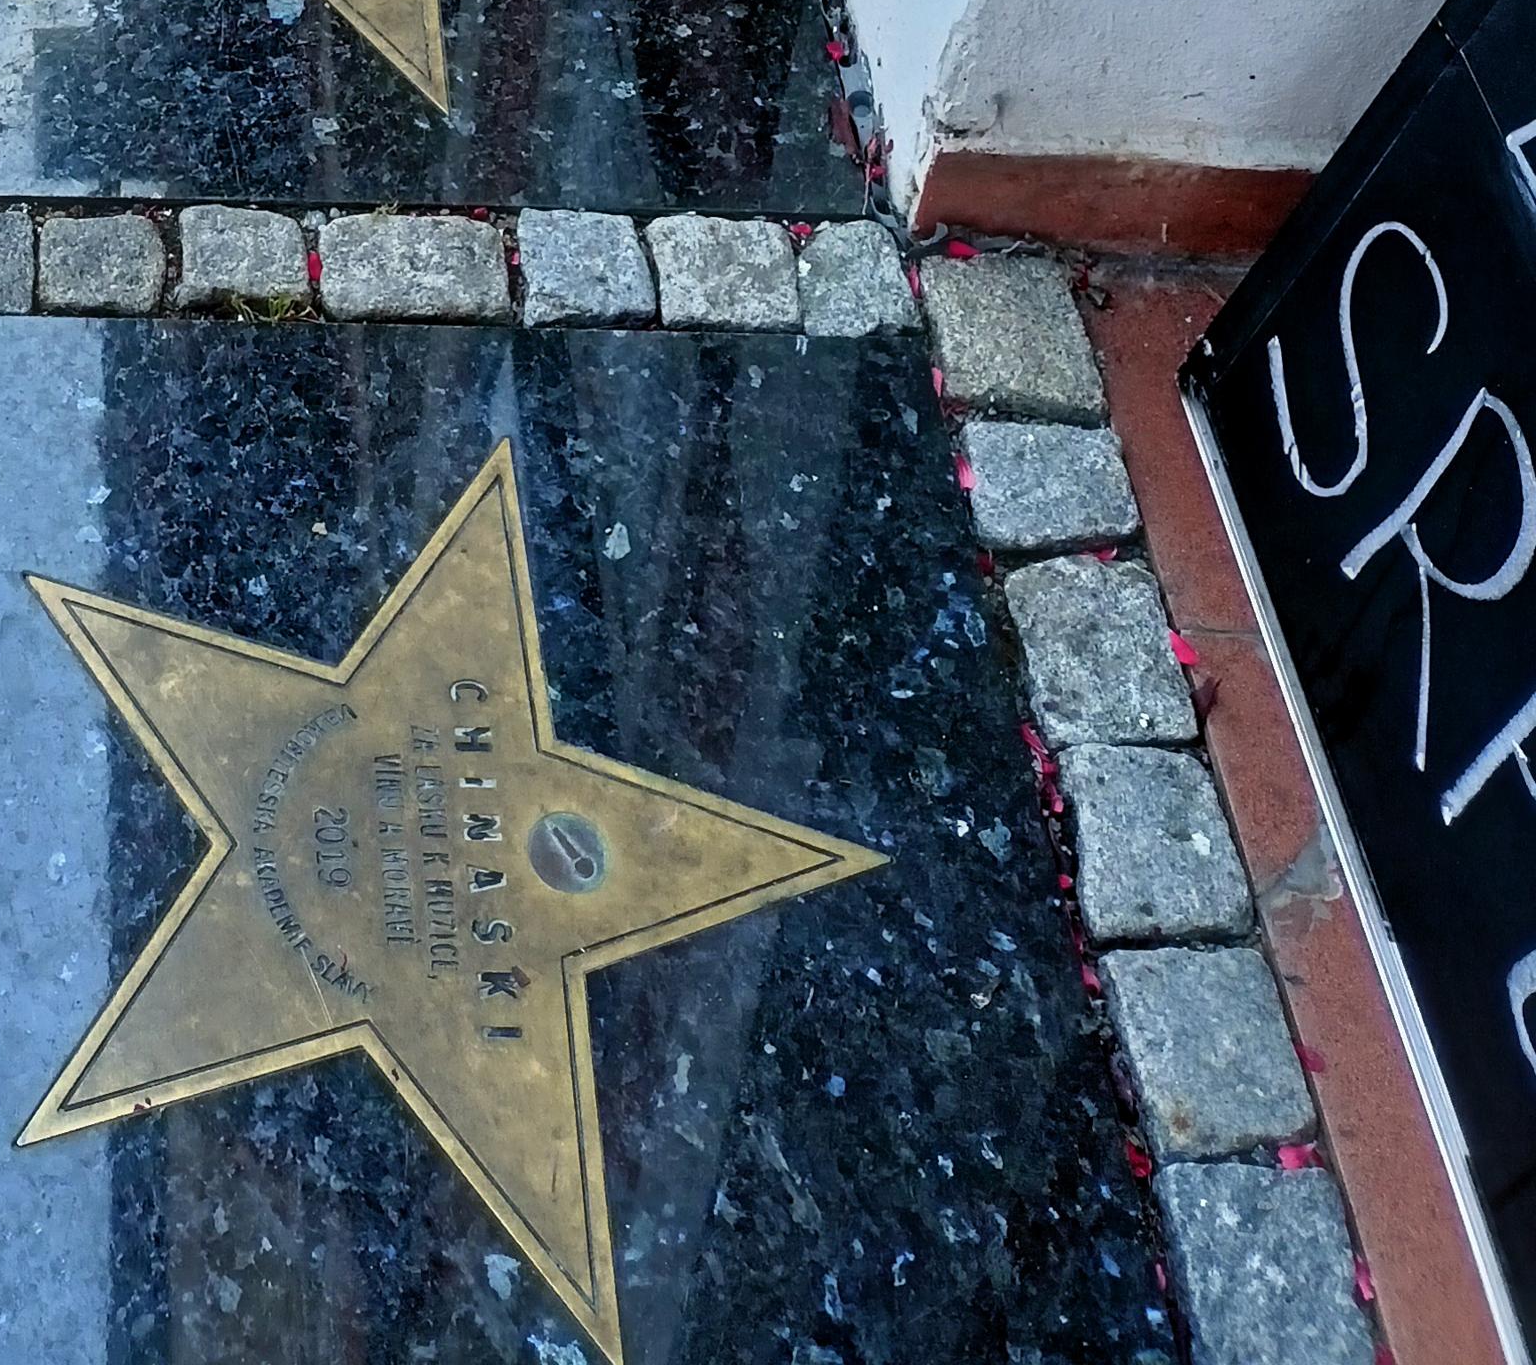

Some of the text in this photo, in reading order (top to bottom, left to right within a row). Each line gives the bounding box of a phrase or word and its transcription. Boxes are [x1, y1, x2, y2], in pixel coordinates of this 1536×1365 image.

[410, 725, 441, 751] ZA
[379, 821, 404, 834] A
[313, 804, 353, 888] 2019
[423, 852, 451, 866] K
[449, 679, 524, 1039] CHINASKI
